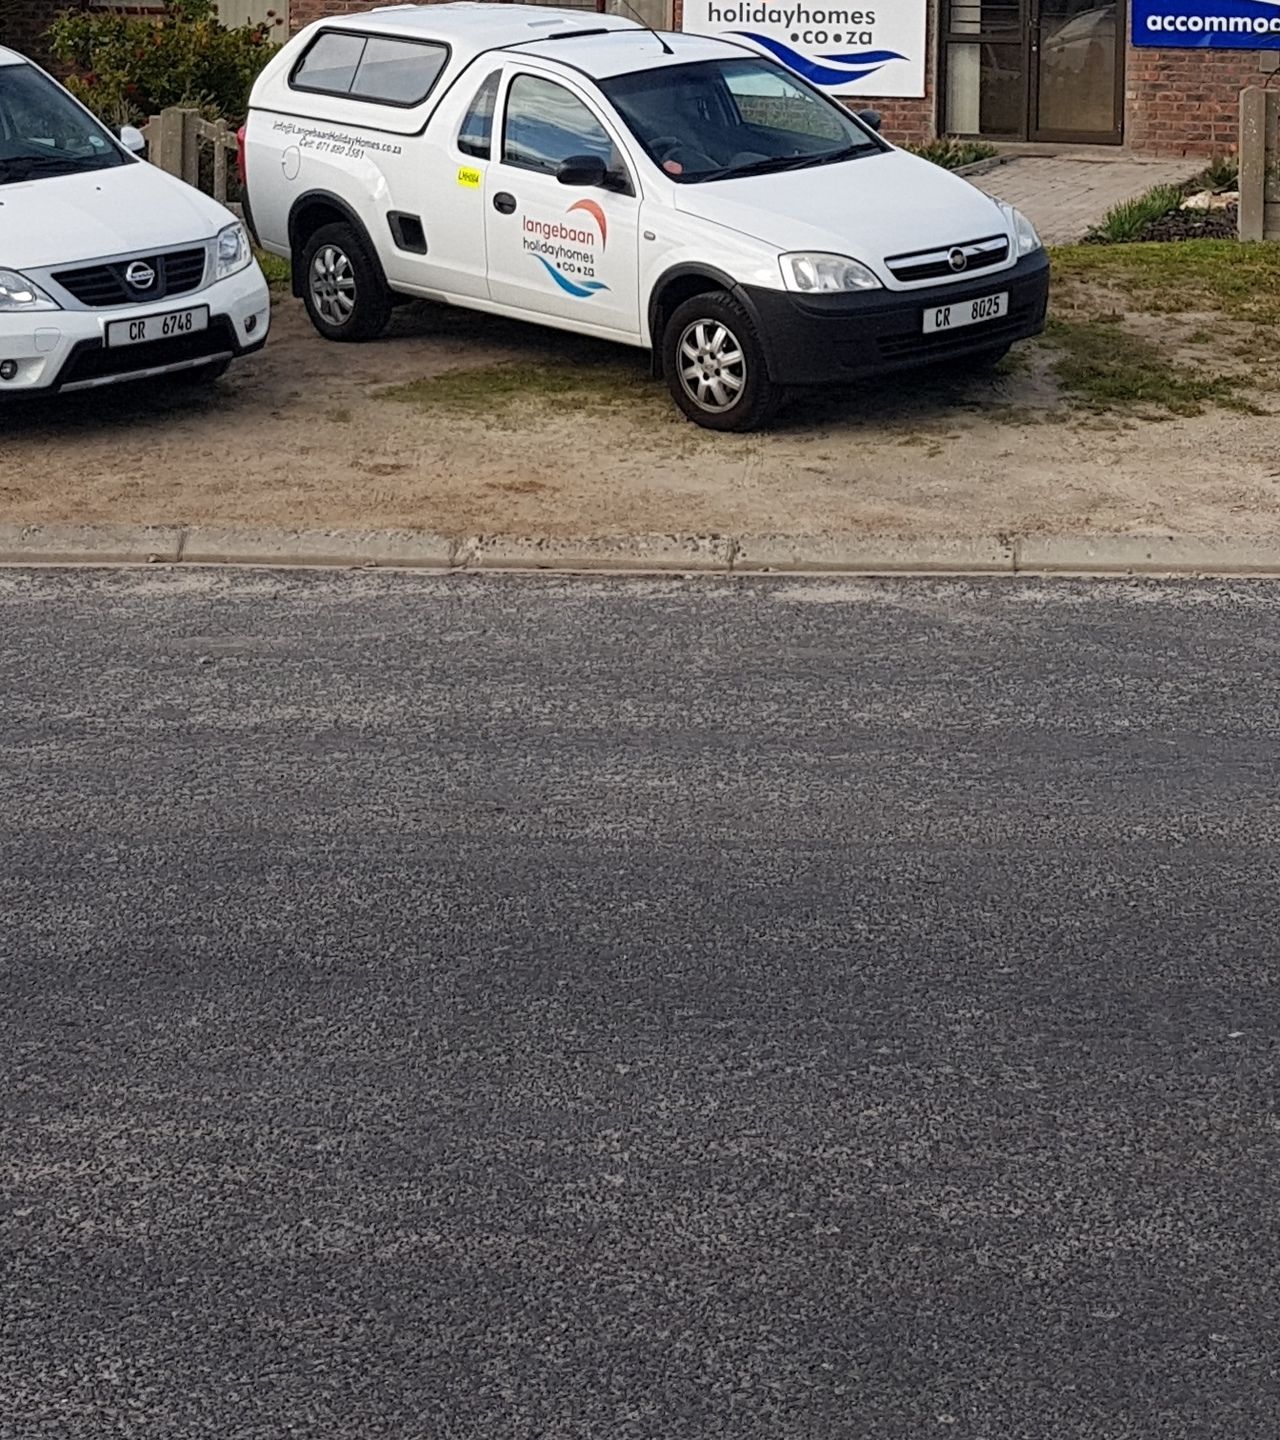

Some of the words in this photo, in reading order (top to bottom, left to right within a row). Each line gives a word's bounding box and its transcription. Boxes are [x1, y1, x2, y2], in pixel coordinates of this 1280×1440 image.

[708, 2, 876, 28] holidayhomes
[523, 215, 594, 245] langebaan
[523, 236, 594, 264] holidayhomes
[129, 321, 146, 340] CR
[162, 312, 192, 335] 6748
[935, 307, 951, 328] CR
[971, 296, 1000, 320] 8025
